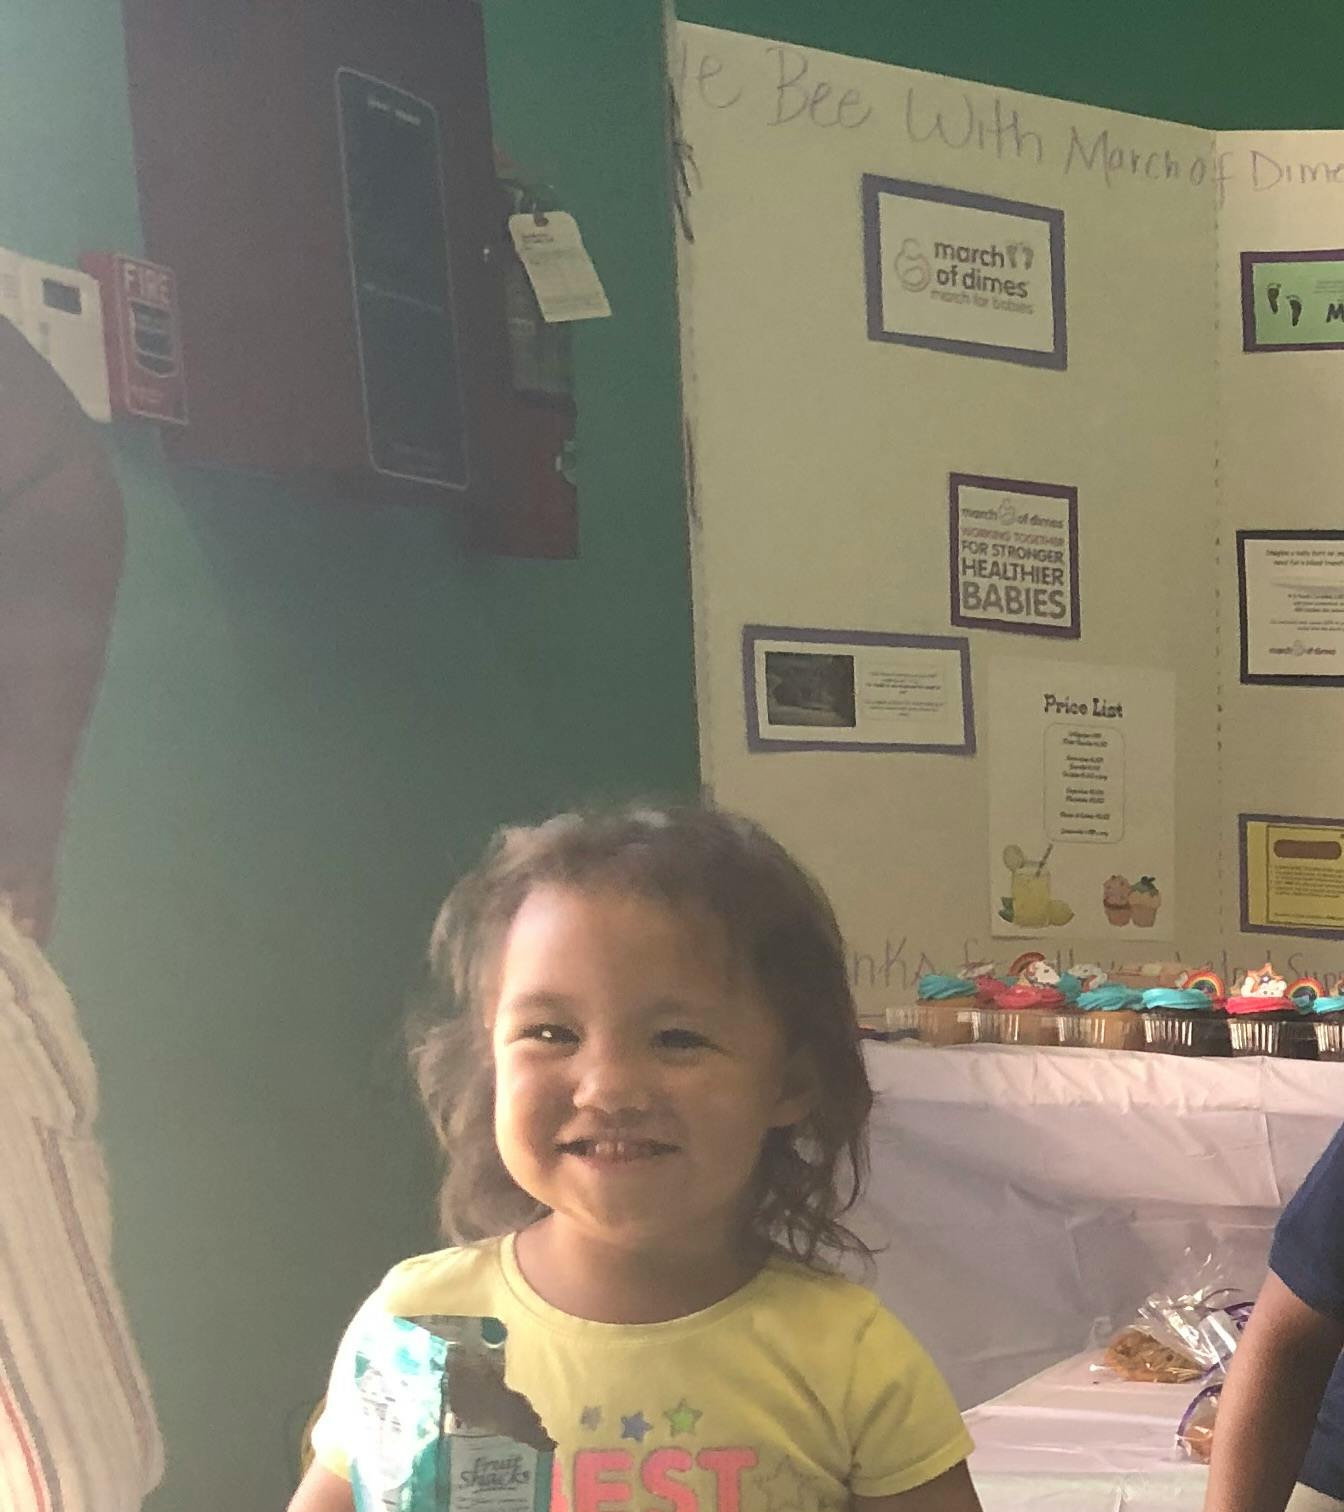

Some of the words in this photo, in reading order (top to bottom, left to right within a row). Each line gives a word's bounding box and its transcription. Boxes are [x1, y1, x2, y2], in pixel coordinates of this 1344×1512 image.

[766, 44, 874, 129] Bee
[904, 85, 1044, 163] With
[1062, 125, 1180, 184] March
[1186, 146, 1234, 208] of
[934, 242, 1005, 268] march
[936, 265, 958, 287] of
[962, 267, 1028, 299] dimes
[961, 540, 989, 555] FOR
[991, 543, 1065, 566] STRONGER
[961, 556, 1065, 587] HEALTHIER
[962, 581, 1067, 620] BABIES
[1043, 693, 1089, 716] Price
[1092, 697, 1124, 719] List
